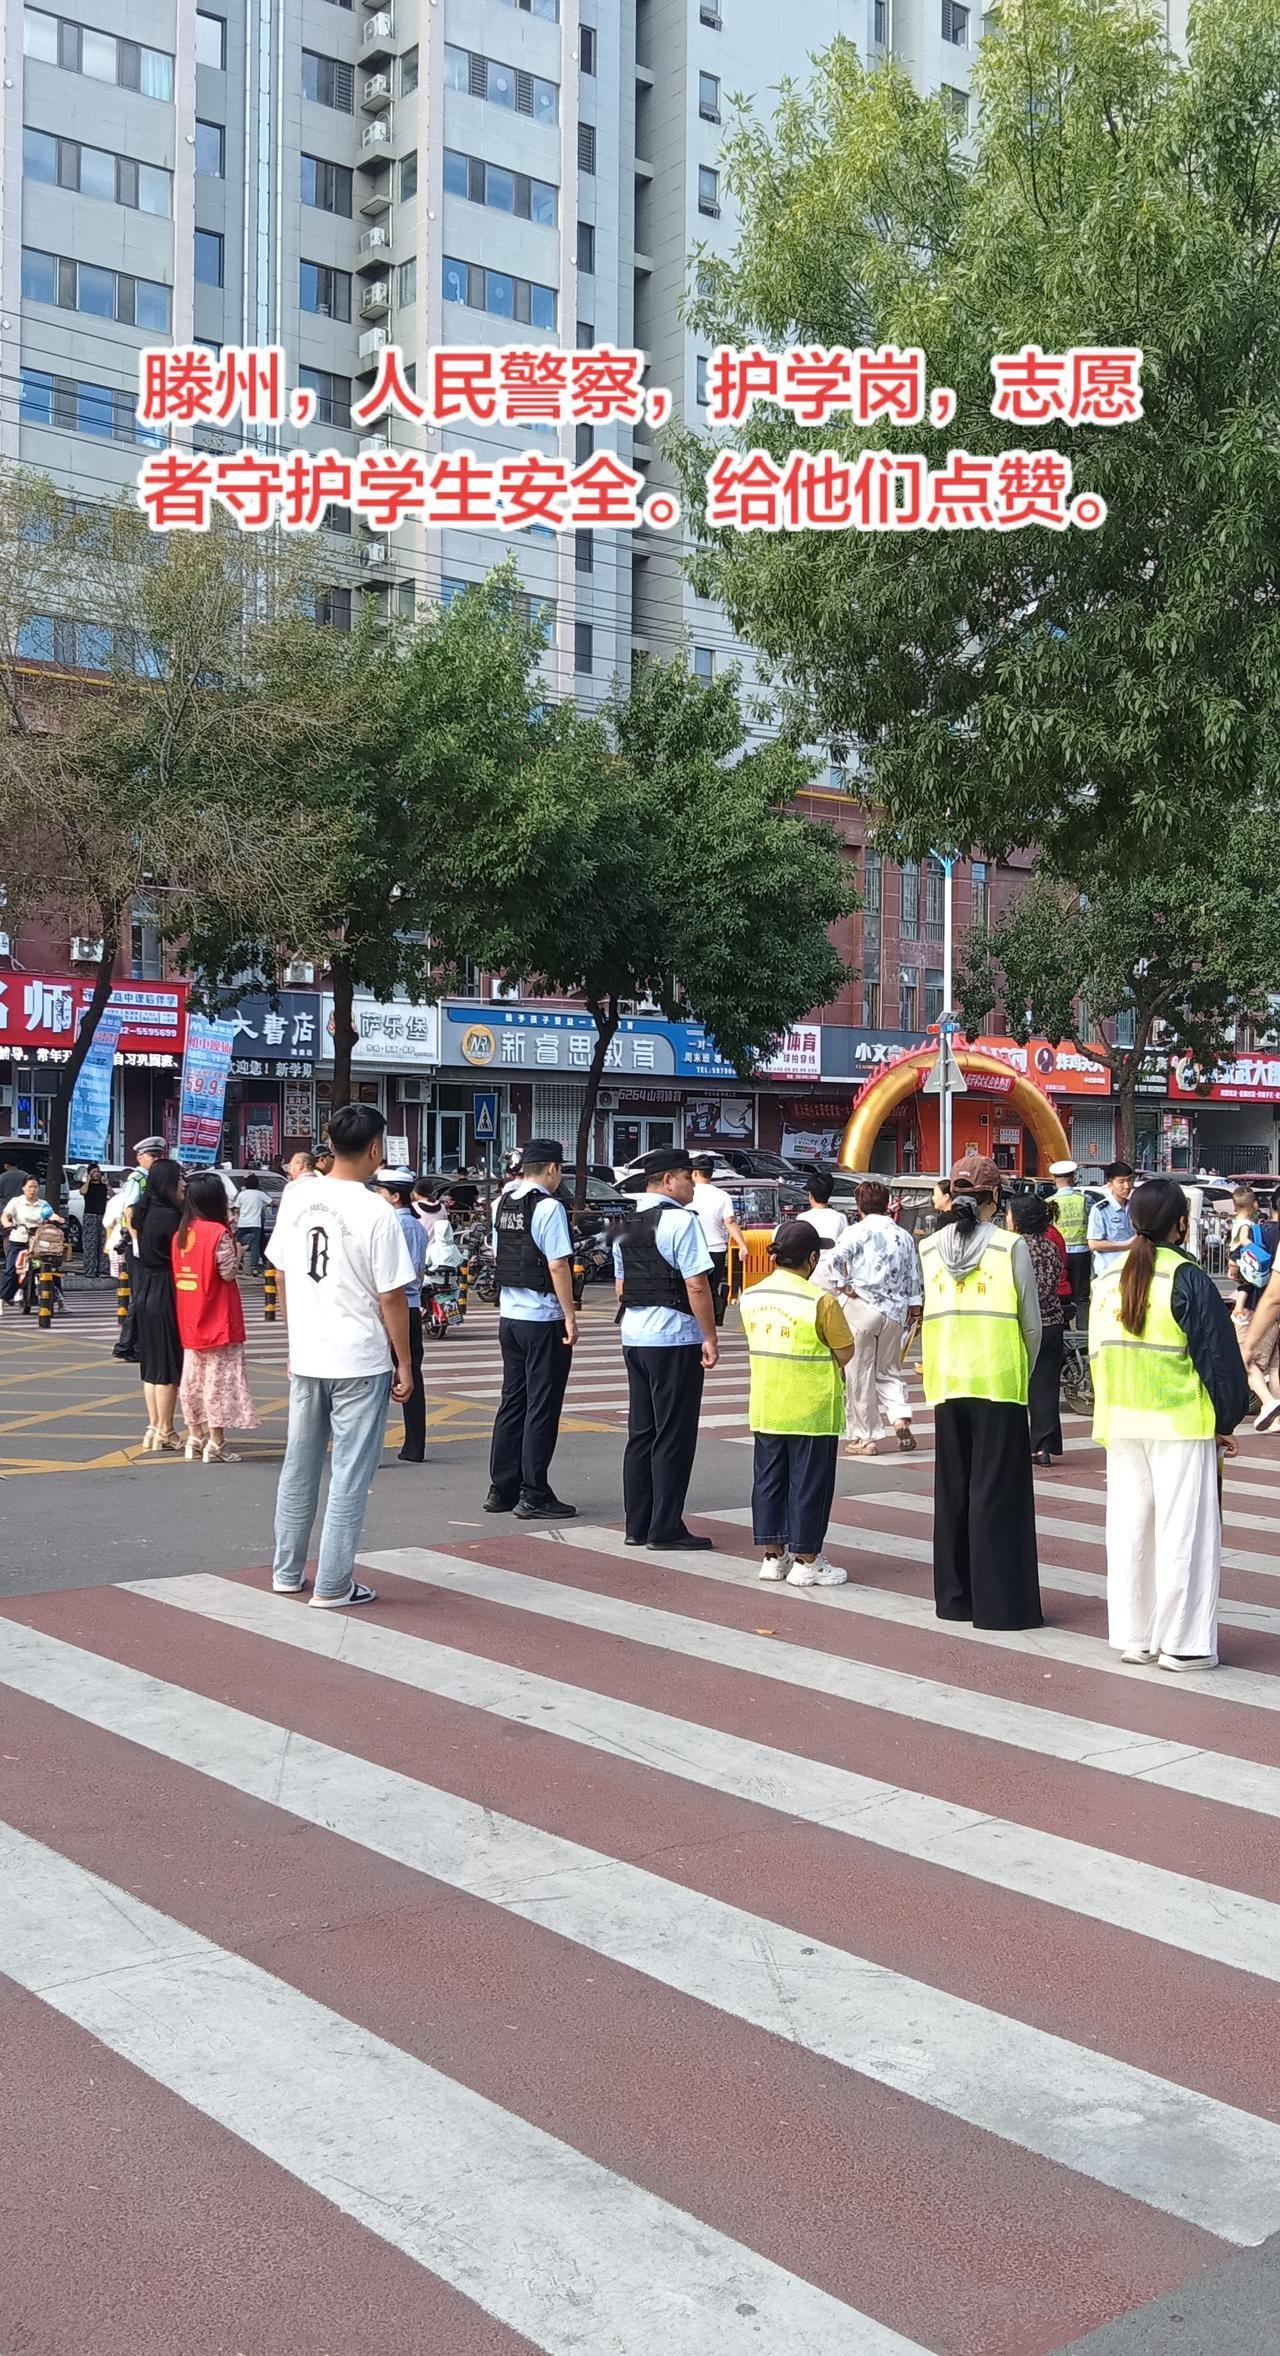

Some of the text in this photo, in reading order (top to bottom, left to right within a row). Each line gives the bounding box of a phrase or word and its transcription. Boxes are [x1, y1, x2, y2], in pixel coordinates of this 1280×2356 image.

[360, 1011, 429, 1042] 萨乐堡
[501, 1031, 655, 1069] 新睿思教育
